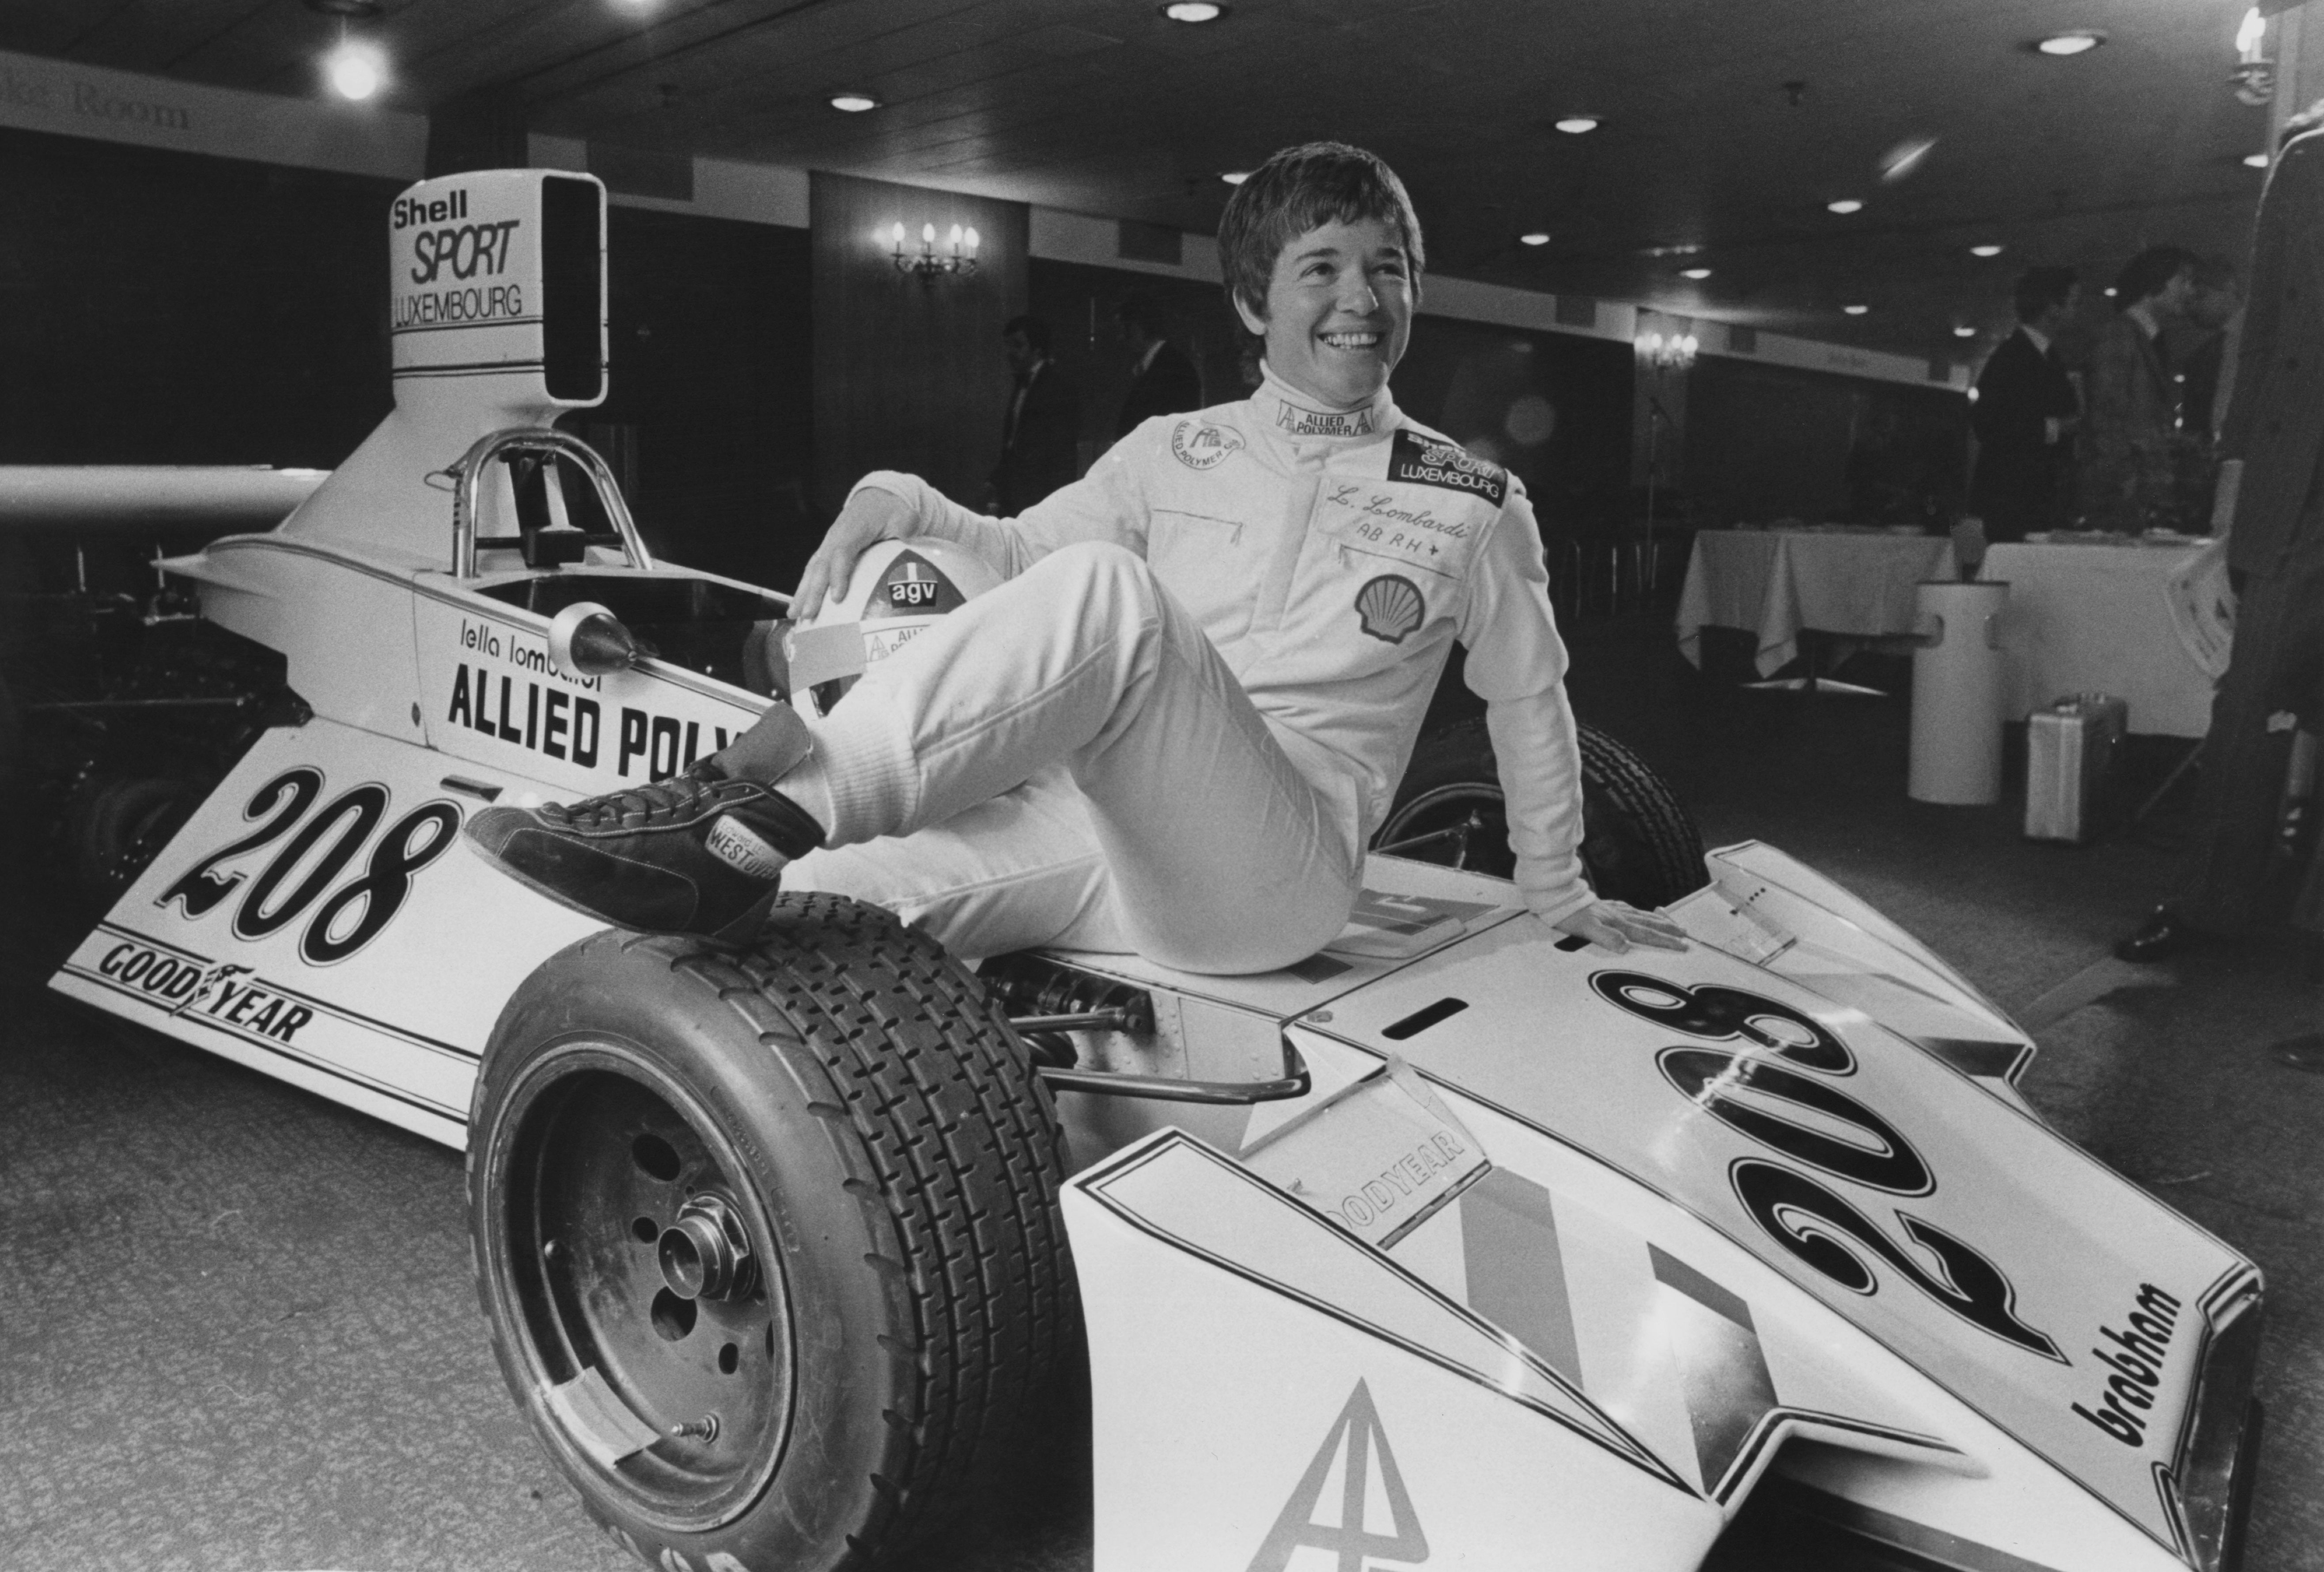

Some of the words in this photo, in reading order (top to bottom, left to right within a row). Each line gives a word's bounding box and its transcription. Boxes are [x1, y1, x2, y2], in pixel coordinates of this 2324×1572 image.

[394, 189, 467, 229] Shell
[411, 219, 520, 284] SPORT
[396, 284, 522, 327] LUXEMBOURG
[1296, 421, 1352, 436] POLYMER
[1306, 413, 1344, 427] ALLIED
[1179, 450, 1223, 466] POLYMER
[1400, 463, 1499, 498] LUXEMBOURG
[1327, 485, 1359, 508] L.
[1363, 495, 1471, 538] Lombardi
[892, 583, 935, 604] agv
[461, 619, 500, 657] lella
[448, 663, 601, 769] ALLIED
[153, 764, 465, 967] 208
[1589, 970, 2073, 1367] 208
[2071, 1283, 2181, 1447] brabham
